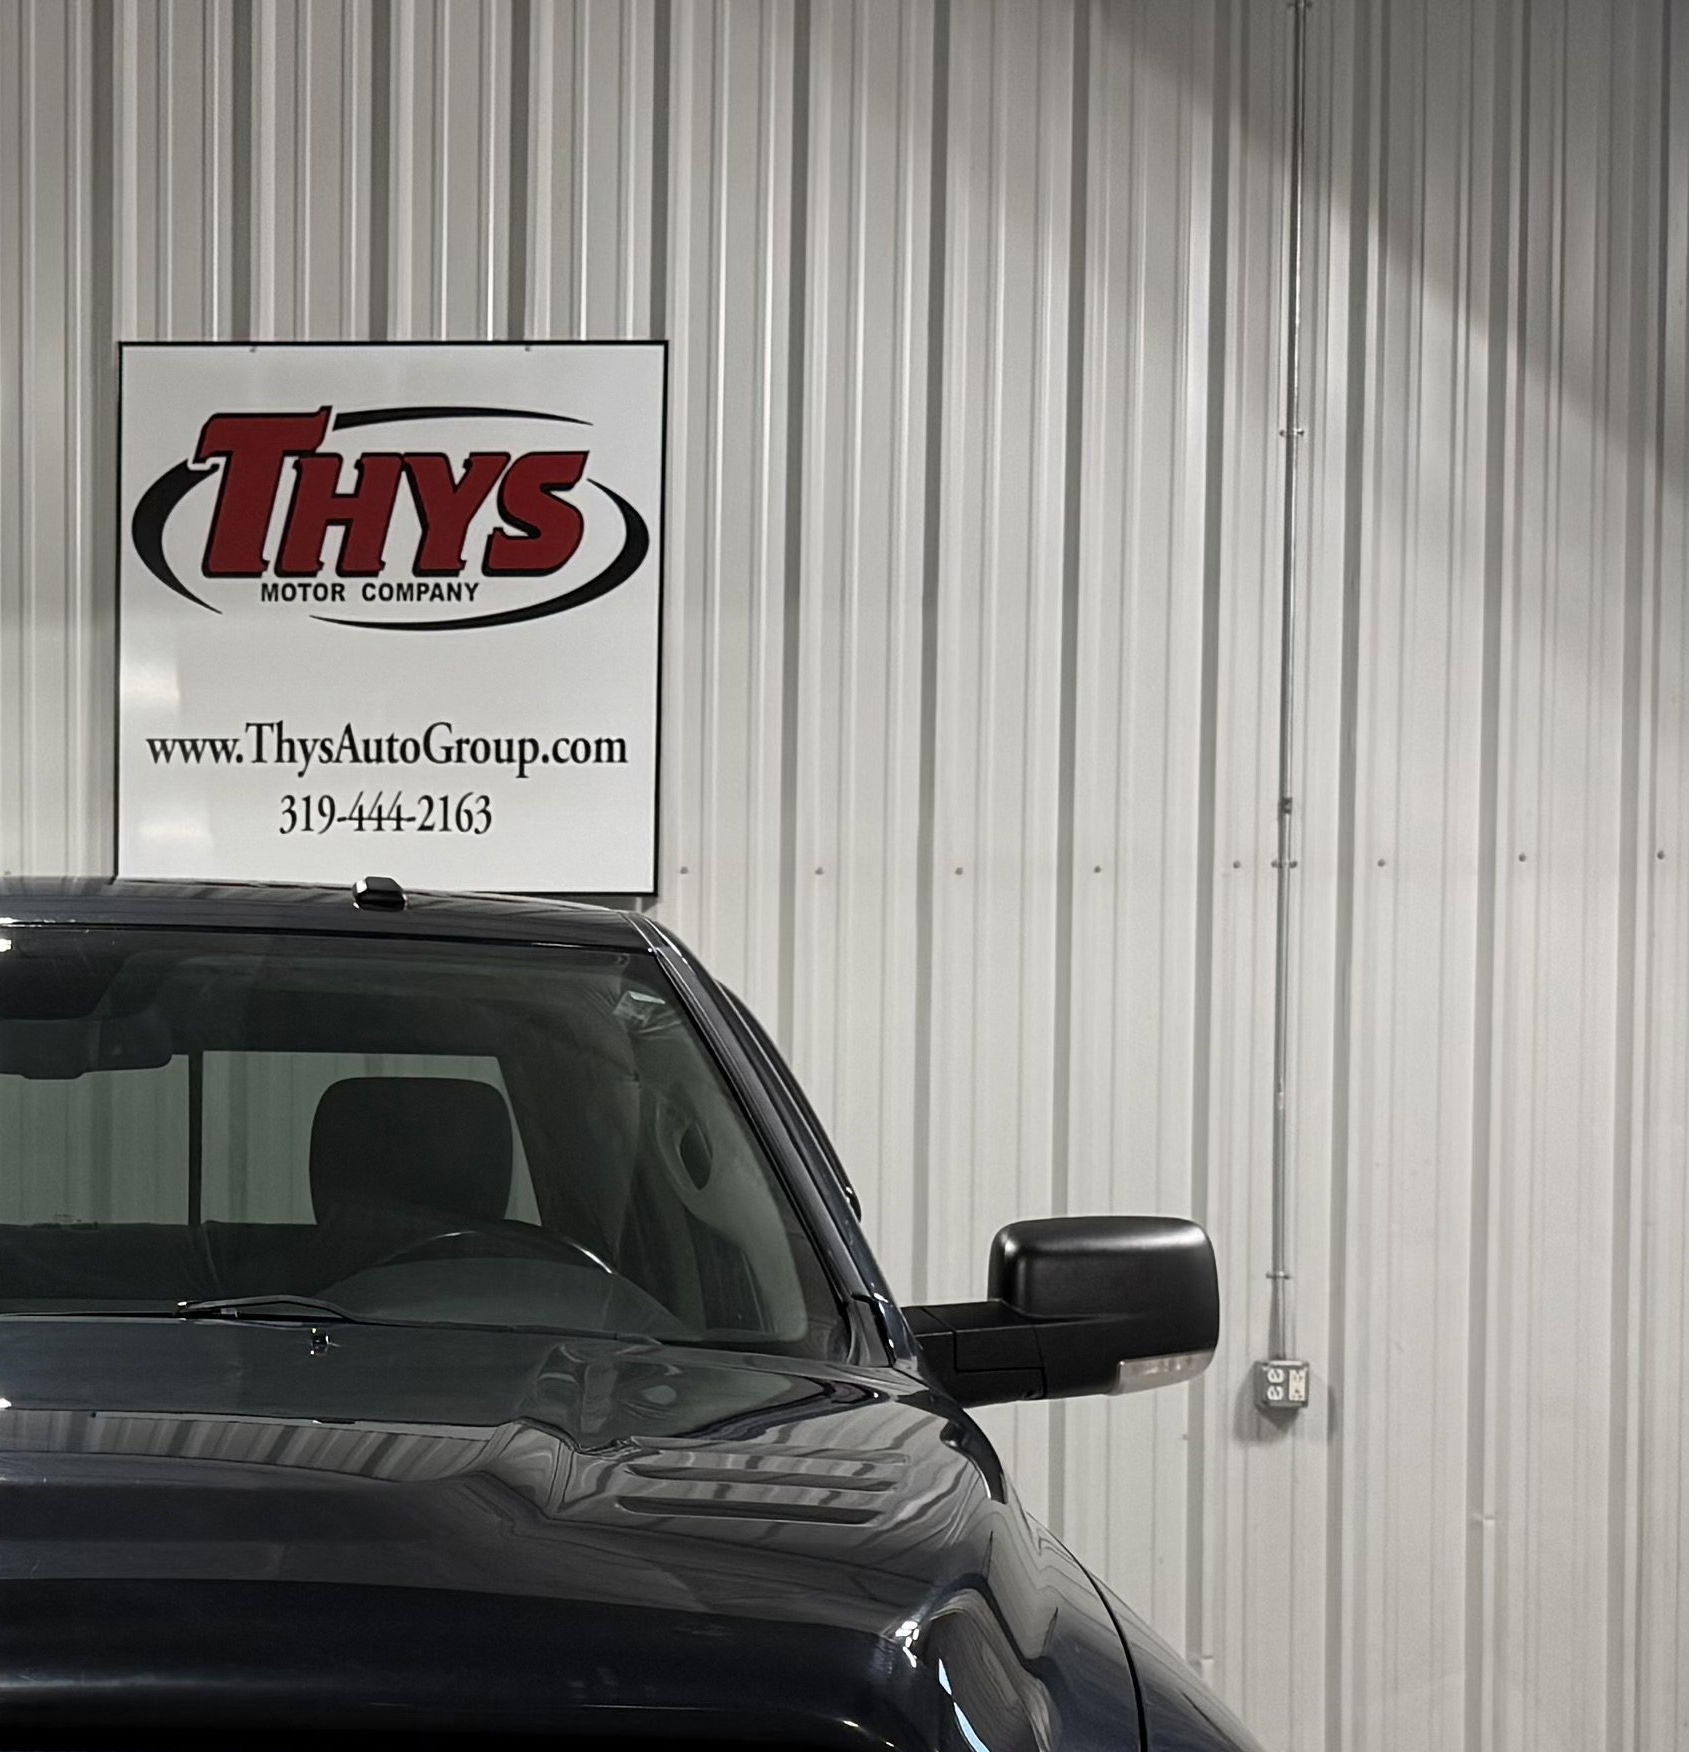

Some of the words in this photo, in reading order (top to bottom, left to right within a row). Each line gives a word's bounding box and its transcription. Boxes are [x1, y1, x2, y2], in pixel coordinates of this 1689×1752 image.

[192, 405, 590, 578] THYS
[260, 582, 346, 602] MOTOR
[361, 582, 480, 602] COMPANY
[145, 720, 628, 778] www.ThysAutoGroup.com
[278, 791, 493, 835] 319-444-2163
